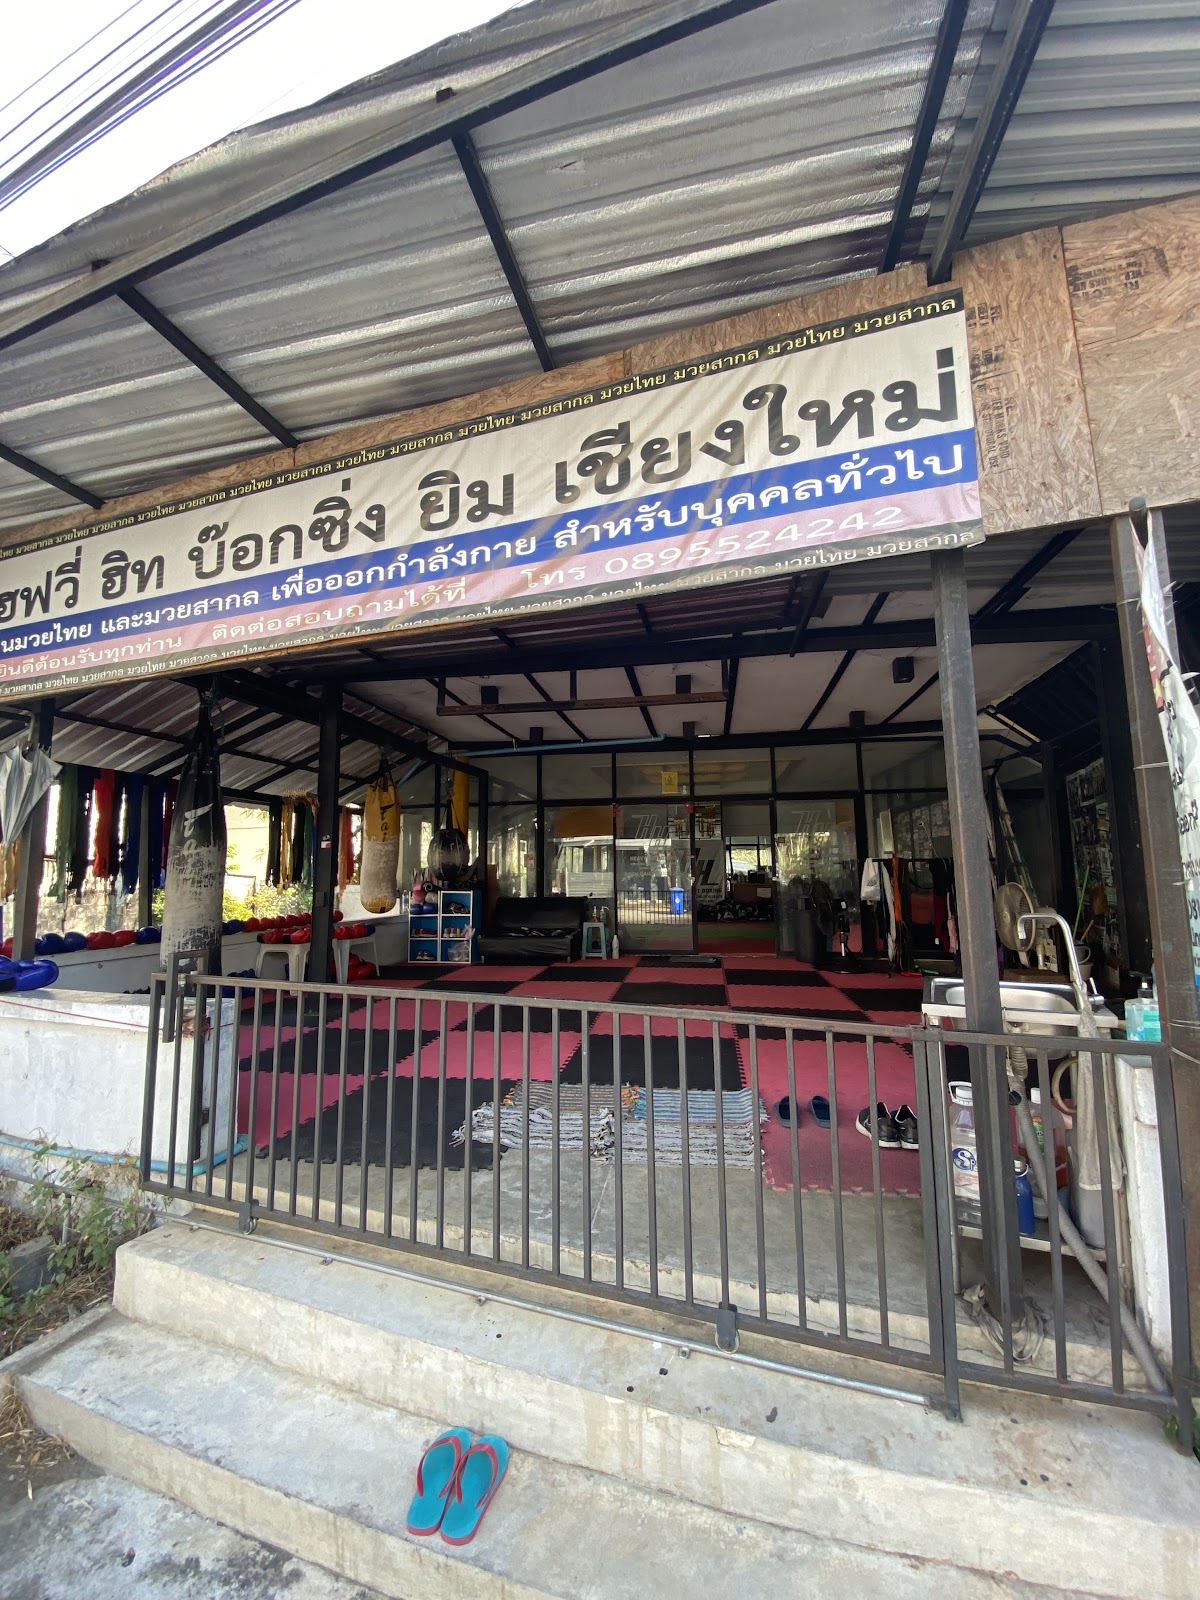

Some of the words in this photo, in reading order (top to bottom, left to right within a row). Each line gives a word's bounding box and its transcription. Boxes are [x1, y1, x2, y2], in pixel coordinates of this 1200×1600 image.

[15, 537, 54, 555] มวยสากล
[56, 528, 90, 544] มวยไทย
[92, 516, 135, 534] มวยสากล
[137, 504, 176, 522] มวยไทย
[178, 491, 226, 511] มวยสากล
[229, 479, 273, 497] มวยไทย
[276, 464, 332, 484] มวยสากล
[336, 449, 386, 470] มวยไทย
[390, 429, 453, 455] มวยสากล
[458, 413, 515, 437] มวยไทย
[521, 393, 594, 421] มวยสากล
[600, 374, 666, 400] มวยไทย
[674, 346, 760, 381] มวยสากล
[767, 326, 845, 356] มวยไทย
[854, 297, 956, 333] มวยสากล
[101, 549, 165, 600] ฮิท
[188, 477, 387, 581] บ๊อกซิ่ง
[417, 469, 515, 532] ยิม
[554, 346, 959, 505] เชียงใหม่
[1, 622, 92, 653] นมวยไทย
[101, 588, 260, 635] และมวยสากล
[271, 535, 537, 601] เพื่อออกกำลังกาย
[554, 444, 963, 550] สำหรับบุคคลทั่วไป
[4, 682, 43, 695] มวยสากล
[45, 674, 79, 689] มวยไทย
[81, 668, 124, 683] มวยสากล
[127, 660, 166, 675] มวยไทย
[867, 531, 975, 557] มวยสากล
[212, 576, 467, 641] ติดต่อสอบถามได้ที่
[519, 565, 587, 589] โทร
[603, 505, 905, 575] 0895524242
